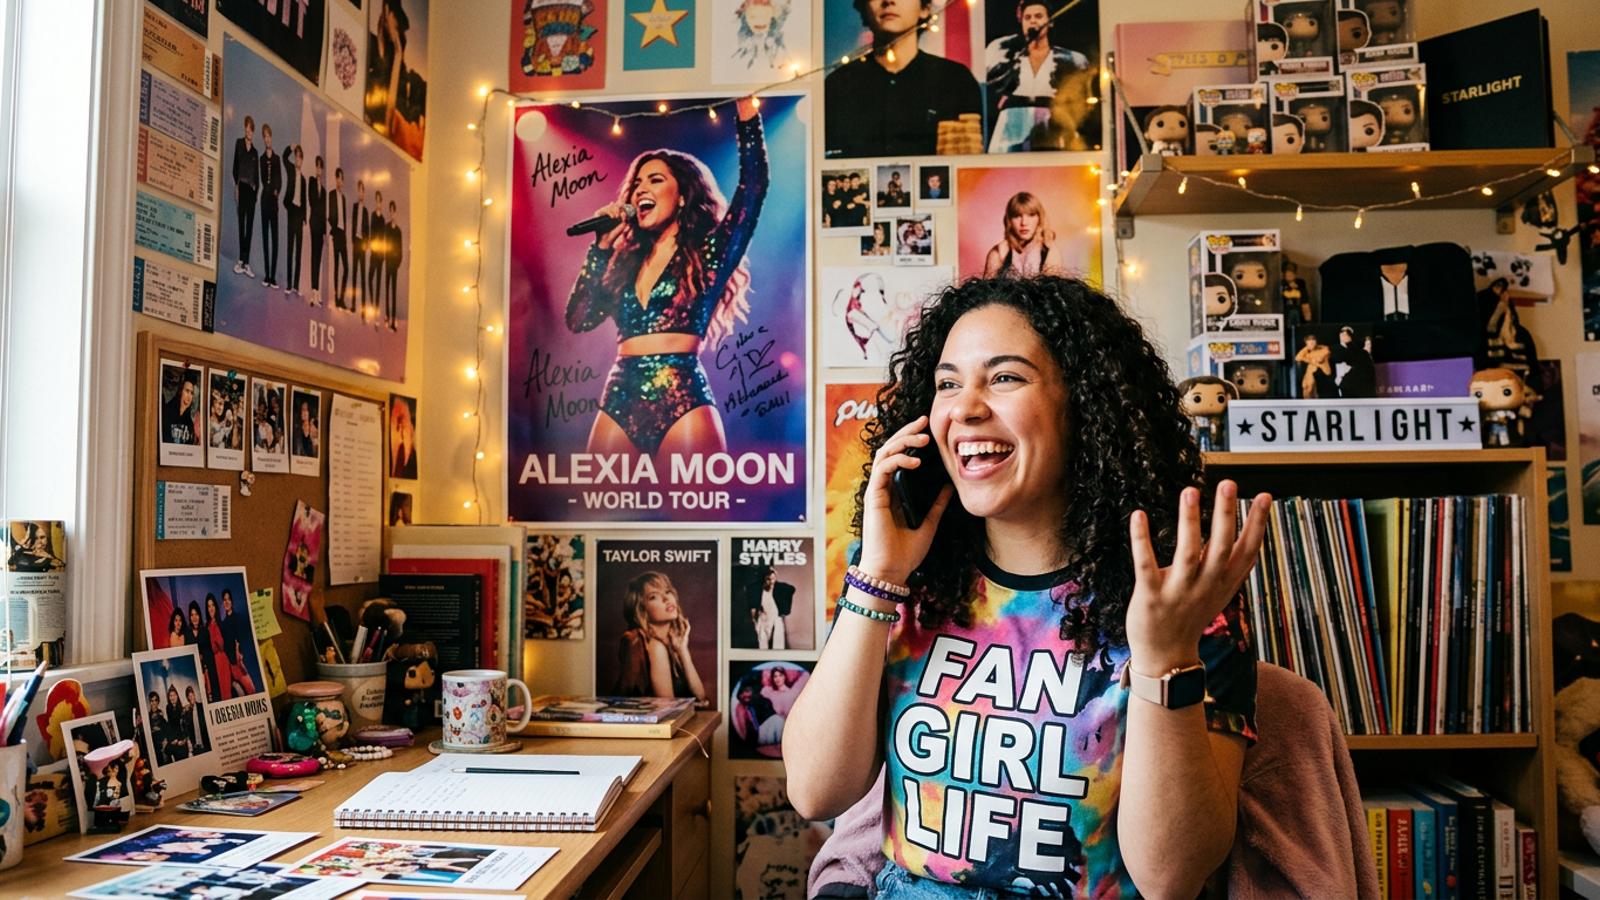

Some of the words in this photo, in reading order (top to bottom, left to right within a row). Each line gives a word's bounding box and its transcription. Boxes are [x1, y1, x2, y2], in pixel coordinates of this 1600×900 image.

[1442, 75, 1522, 104] STARLIGHT
[531, 145, 594, 187] Alexia
[551, 170, 609, 208] Moon
[309, 319, 335, 354] BTS
[523, 348, 600, 399] Alexia
[545, 391, 598, 429] Moon
[1260, 408, 1453, 443] STARLIGHT
[518, 453, 659, 485] ALEXIA
[670, 452, 795, 485] MOON
[582, 491, 663, 509] WORLD
[668, 490, 730, 509] TOUR
[602, 549, 661, 563] TAYLOR
[664, 549, 712, 563] SWIFT
[738, 552, 807, 566] STYLES
[742, 539, 804, 553] HARRY
[916, 633, 1086, 717] FAN
[894, 702, 1090, 799] GIRL
[902, 777, 1072, 874] LIFE
